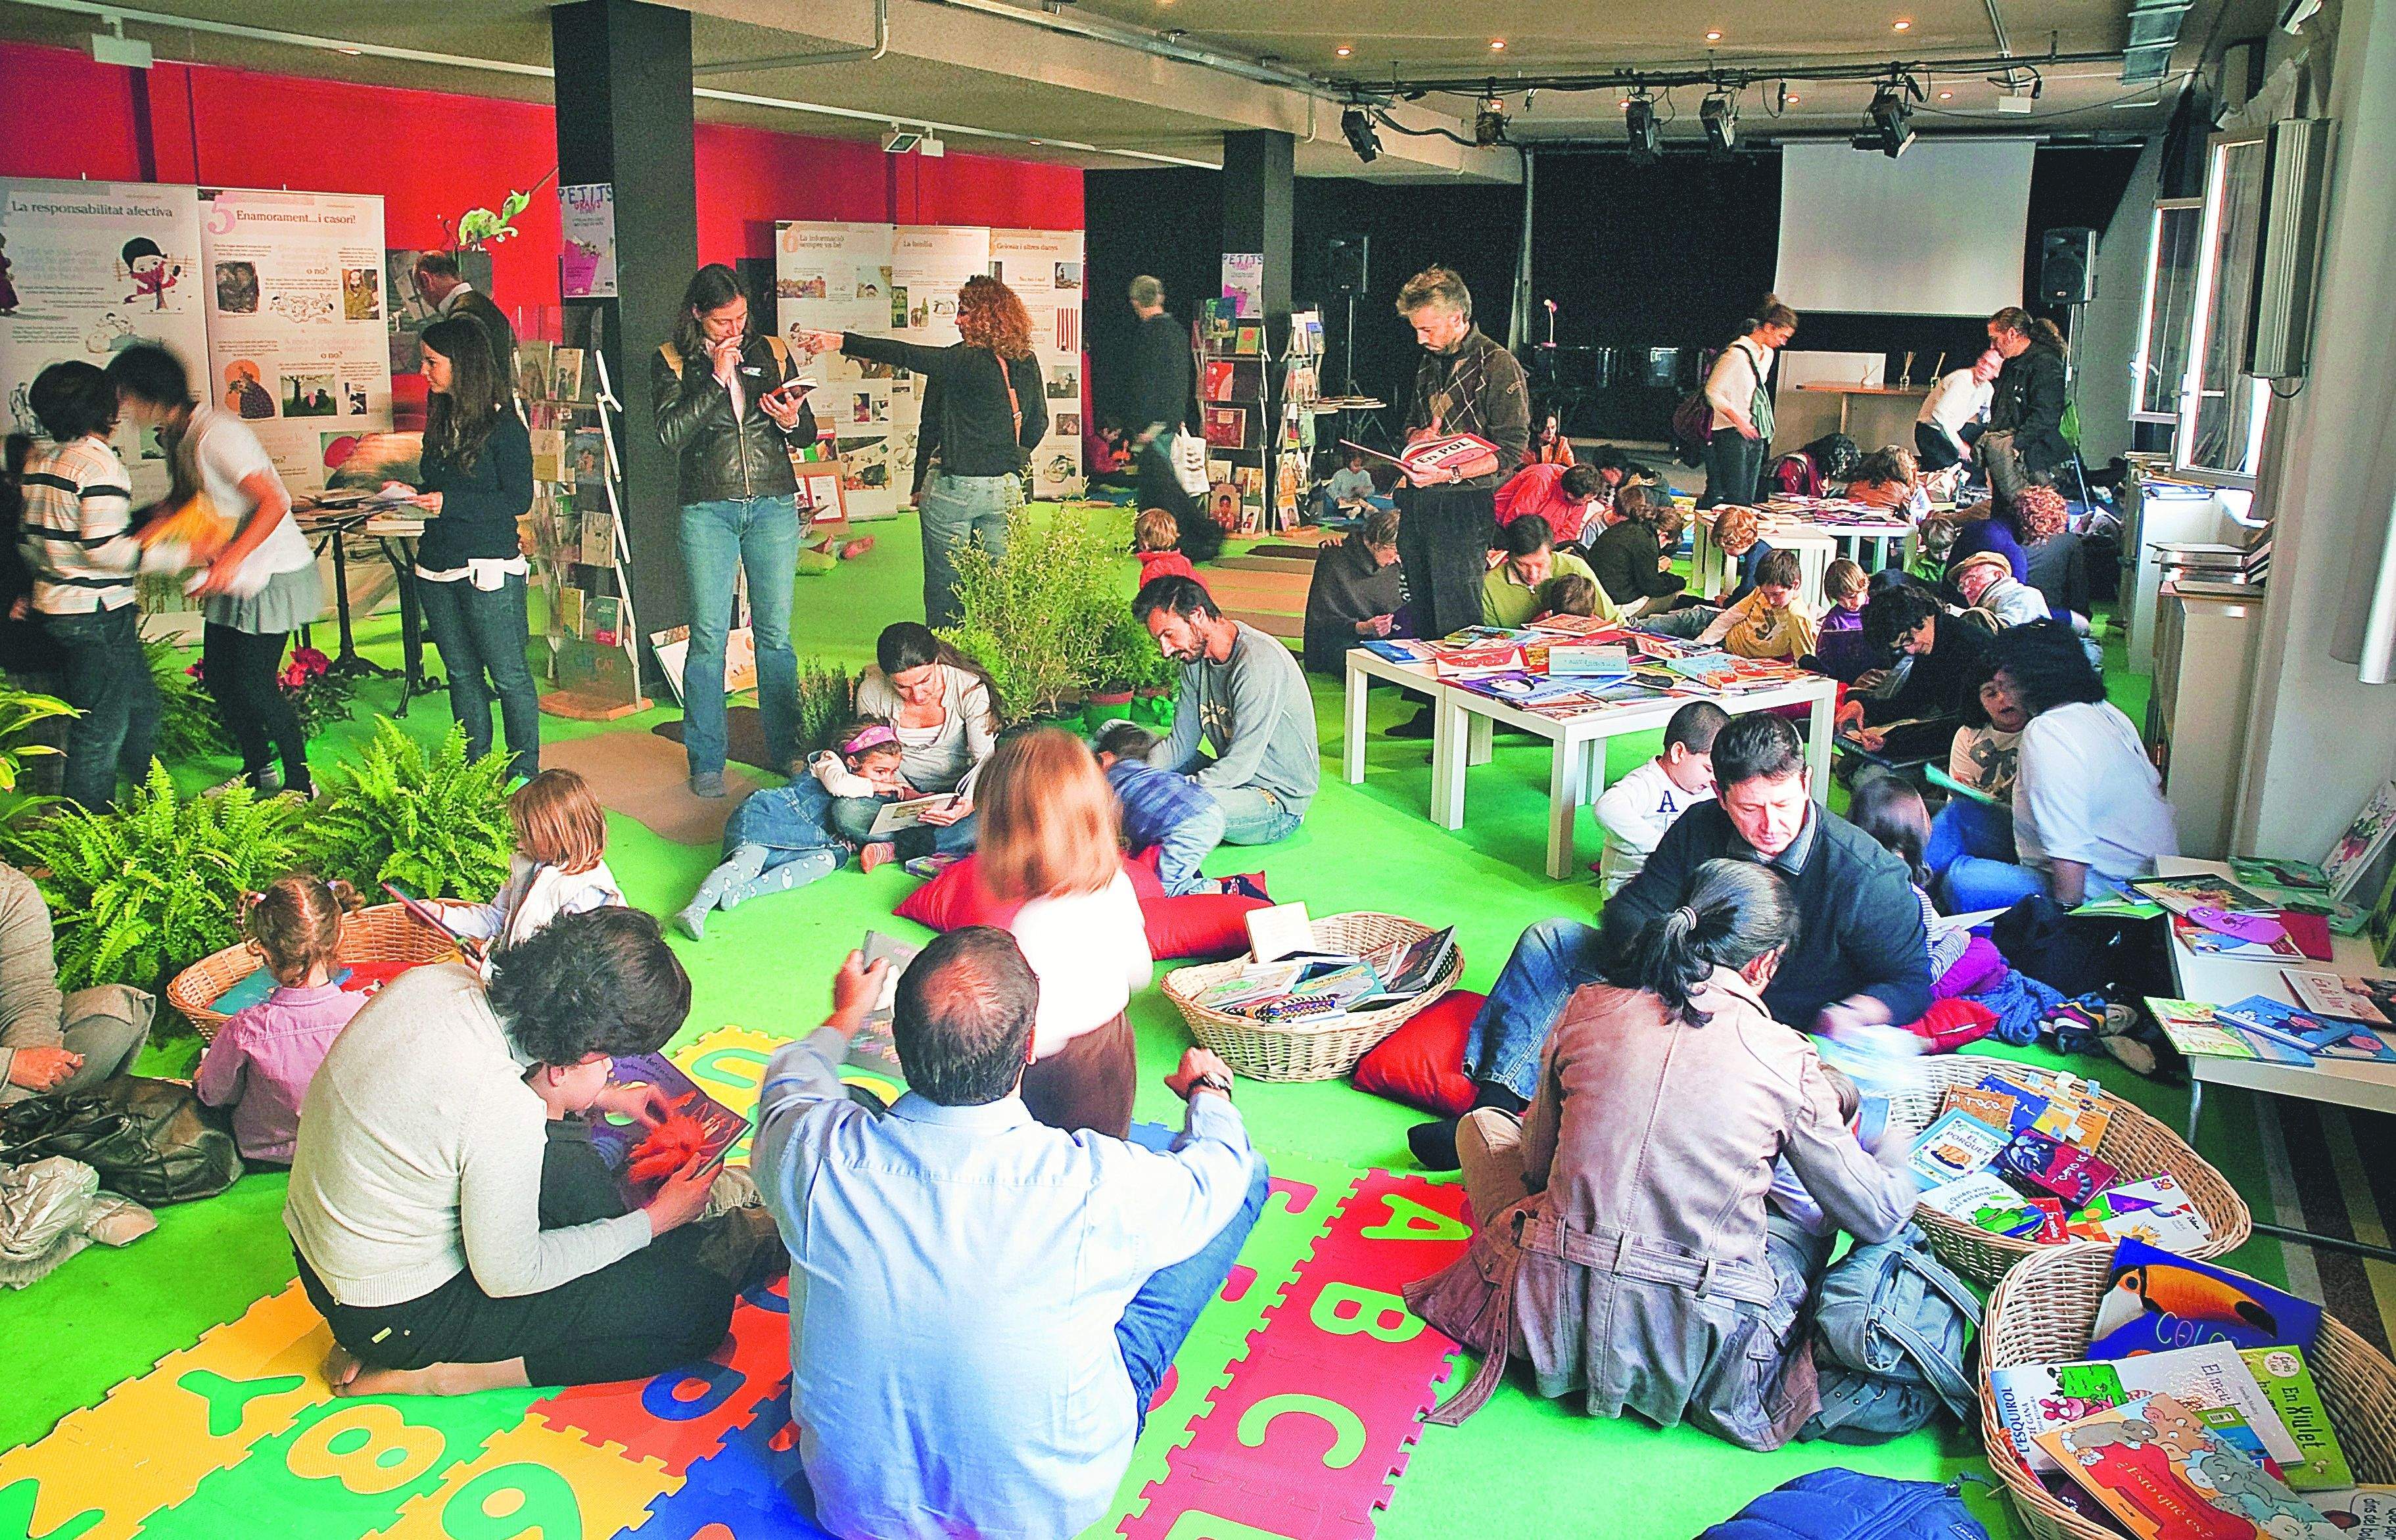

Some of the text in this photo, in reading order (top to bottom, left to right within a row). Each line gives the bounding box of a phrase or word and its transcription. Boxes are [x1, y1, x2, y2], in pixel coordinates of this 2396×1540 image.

[557, 185, 613, 204] PETITS
[12, 200, 173, 217] La responsabilitat afectiva
[207, 192, 236, 235] 5
[1223, 254, 1263, 265] PETITS
[1417, 442, 1470, 463] En POL
[1656, 790, 1679, 813] A
[1947, 1131, 1990, 1157] PORQUET
[1967, 1134, 1978, 1143] EL
[1361, 1194, 1473, 1240] A
[1310, 1282, 1427, 1343] B
[2001, 1387, 2030, 1453] L'ESQUIROL
[2021, 1403, 2034, 1424] GANA
[2282, 1386, 2327, 1449] En Xiulet
[1237, 1393, 1367, 1469] C
[286, 1404, 447, 1495] 8
[2363, 1514, 2381, 1526] del
